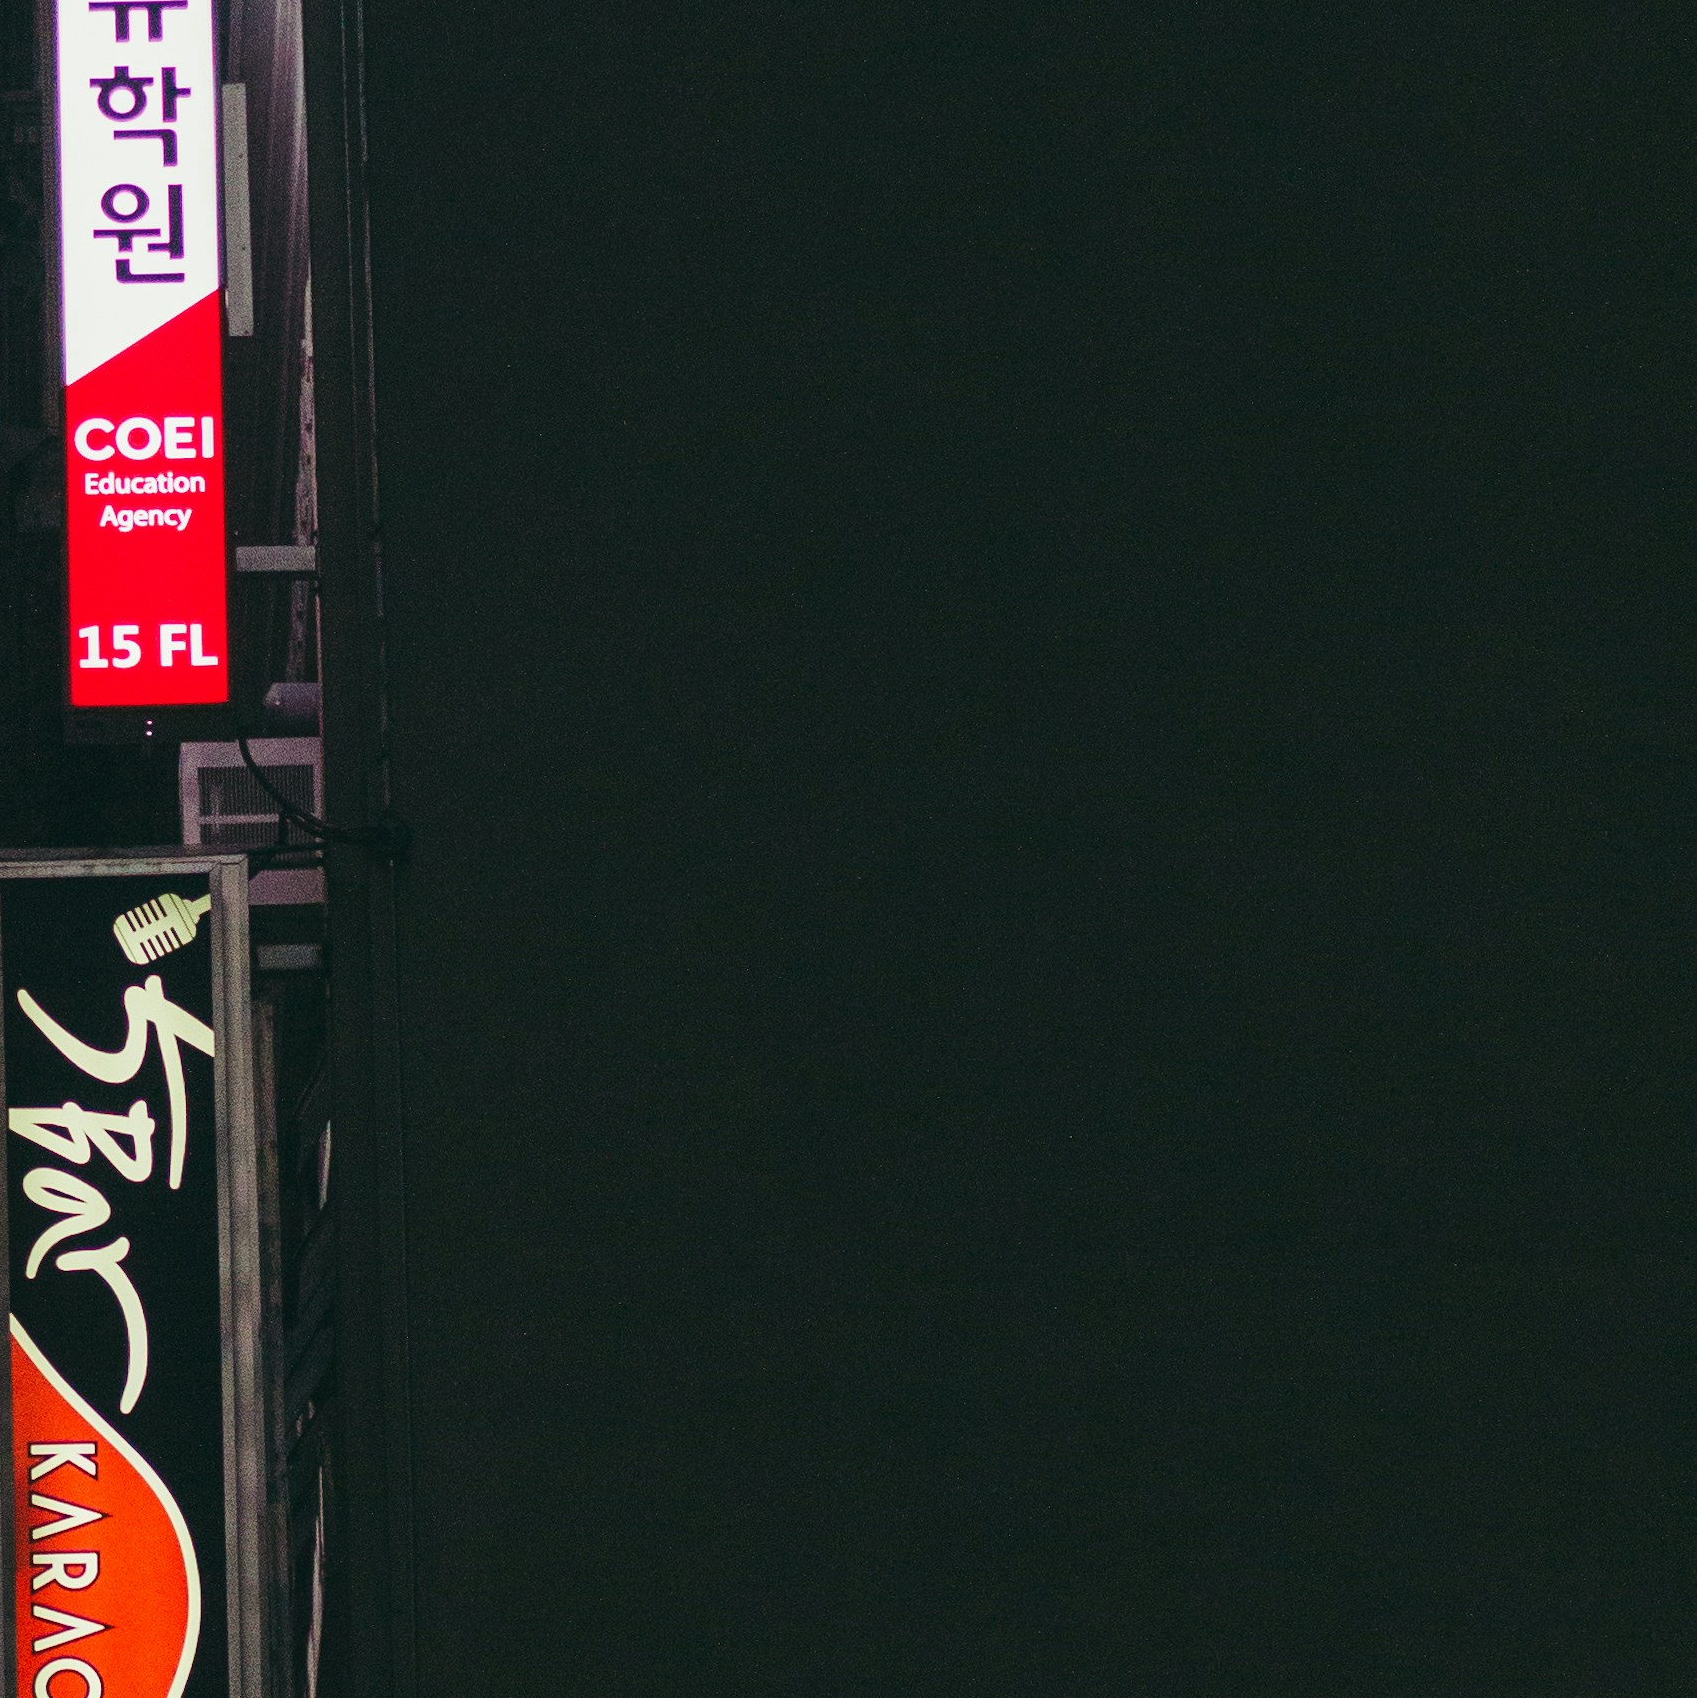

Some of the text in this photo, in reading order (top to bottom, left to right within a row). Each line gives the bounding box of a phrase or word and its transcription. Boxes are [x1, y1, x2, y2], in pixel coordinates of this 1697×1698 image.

[74, 416, 215, 461] COEI
[84, 471, 206, 495] Education
[99, 504, 193, 533] Agency
[78, 623, 219, 669] 15 FL
